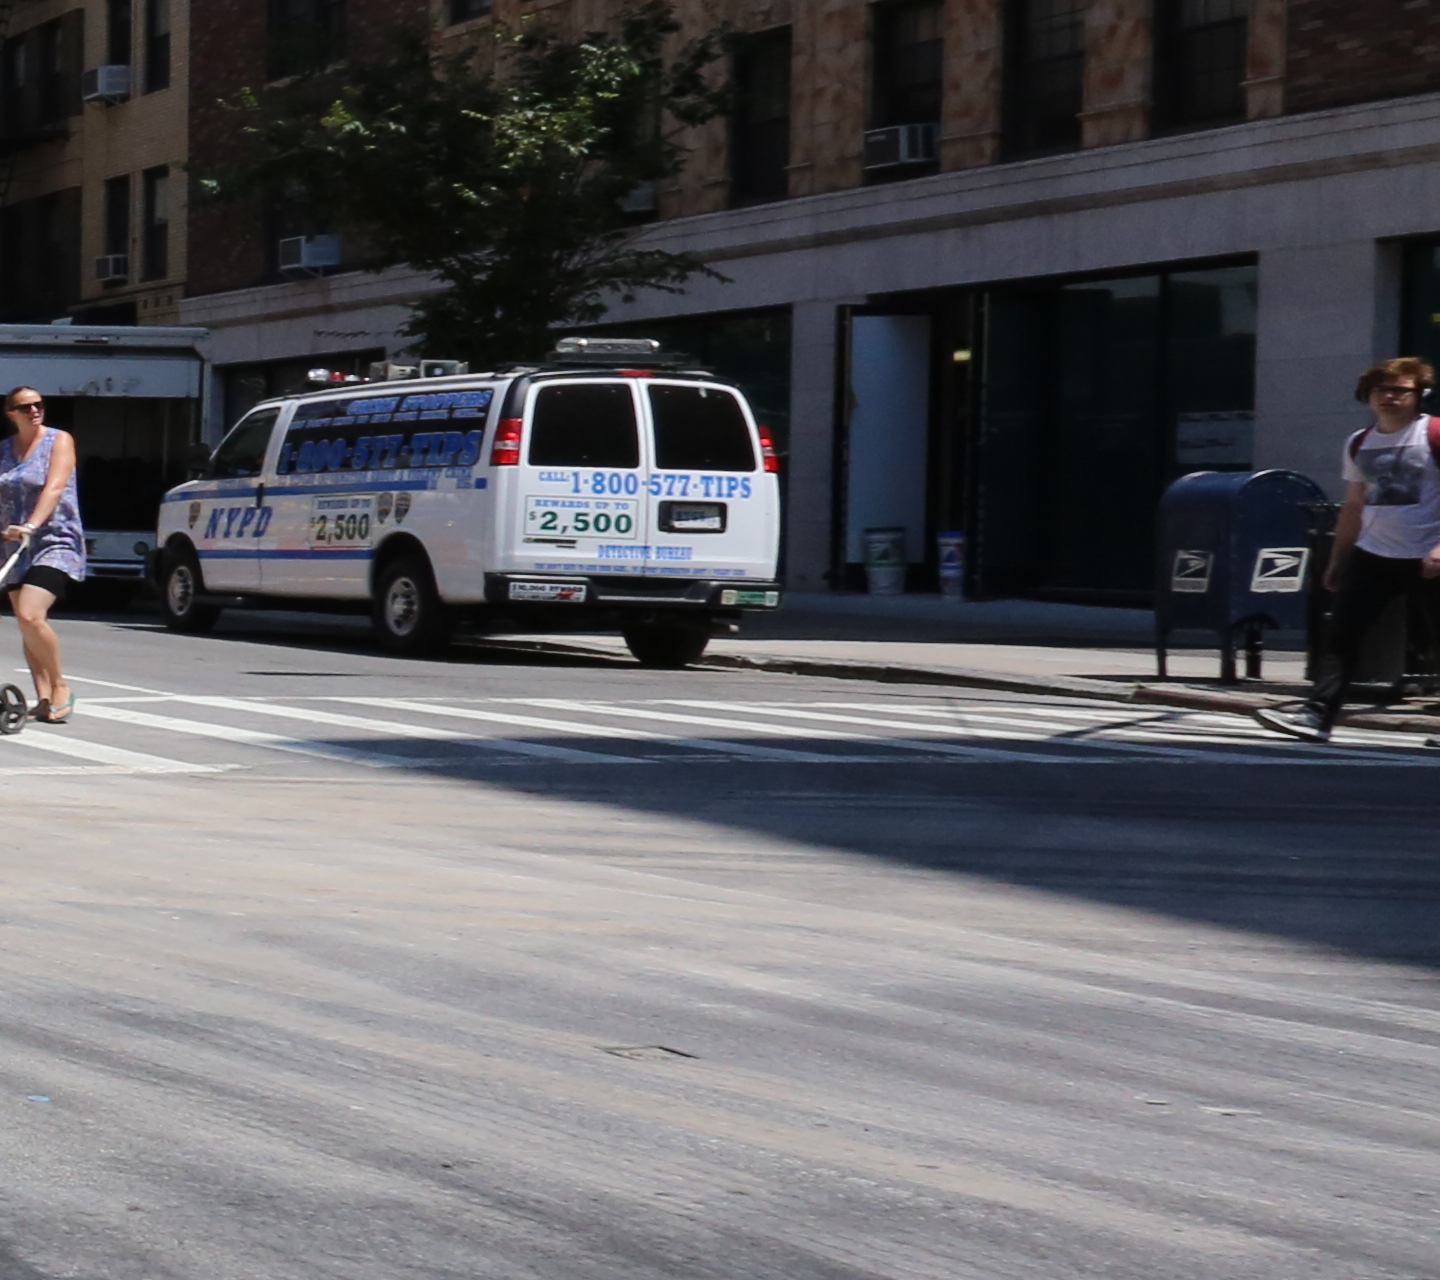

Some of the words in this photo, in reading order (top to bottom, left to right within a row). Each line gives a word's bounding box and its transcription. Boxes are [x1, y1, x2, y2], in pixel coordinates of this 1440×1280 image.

[534, 499, 590, 508] REWARDS
[594, 500, 610, 509] UP
[614, 501, 629, 510] TO
[203, 505, 273, 539] NYPD
[597, 545, 652, 560] DETECTIVE
[654, 546, 693, 560] BUREAU
